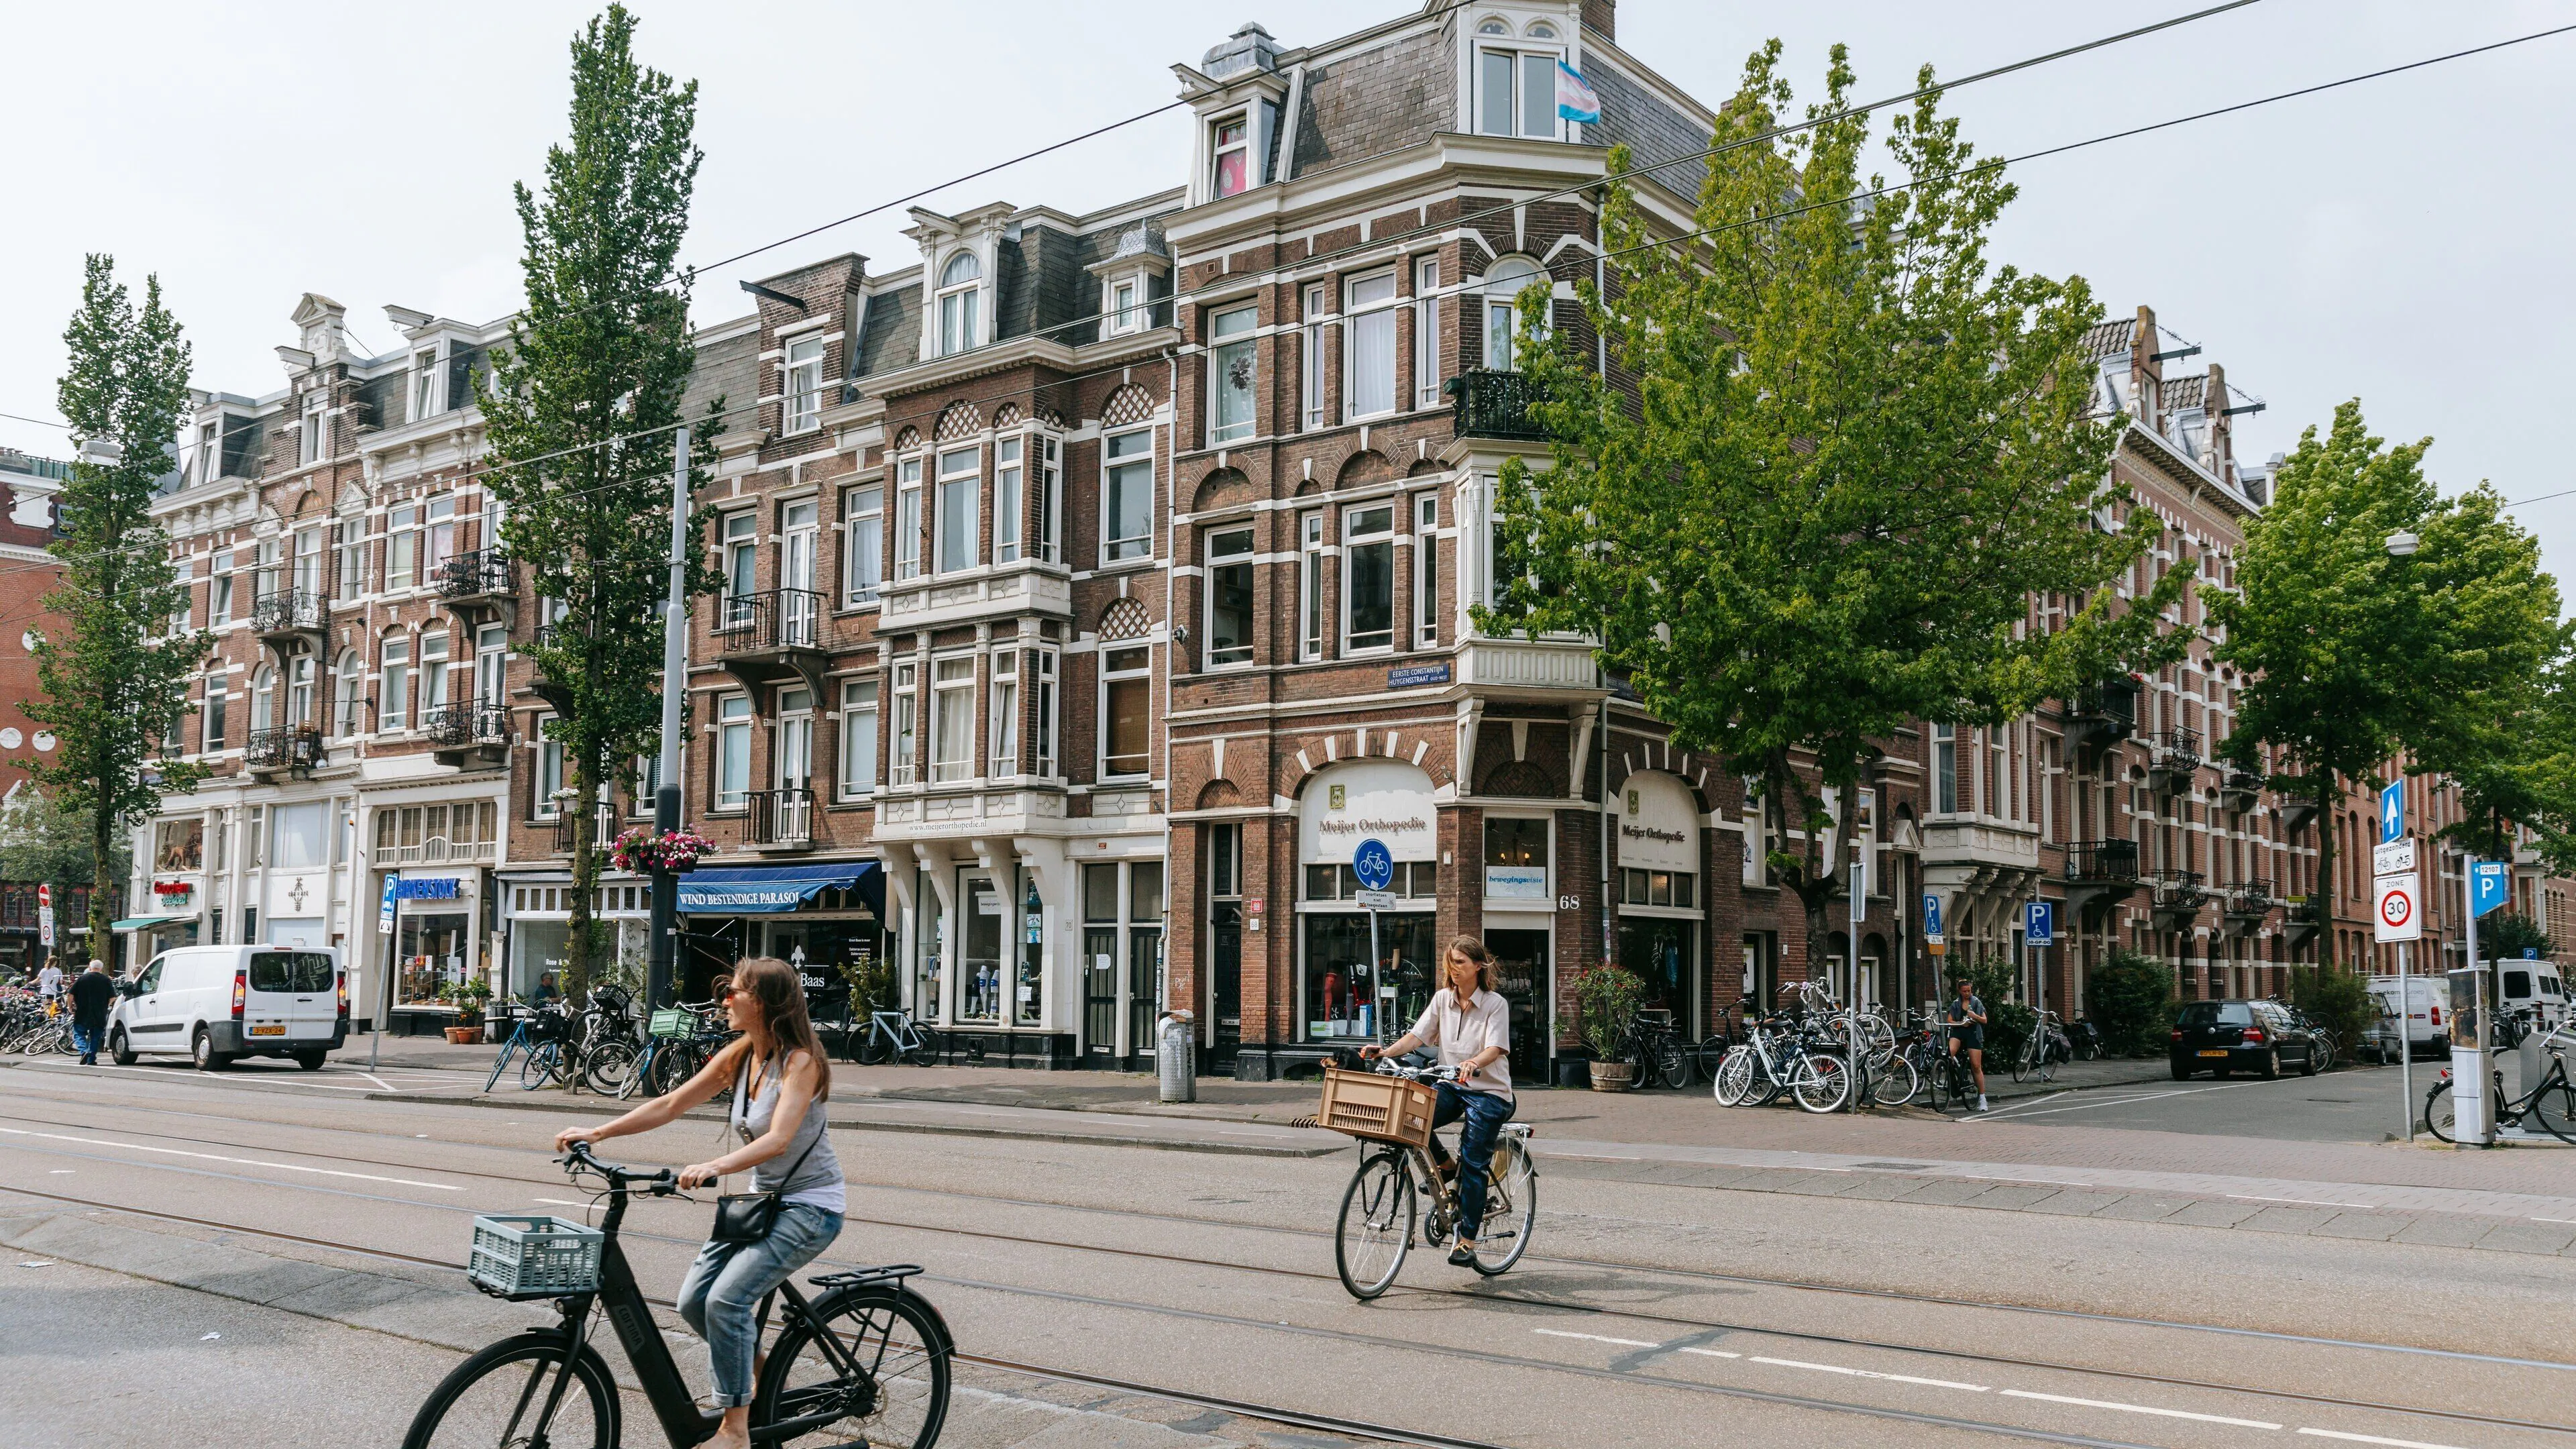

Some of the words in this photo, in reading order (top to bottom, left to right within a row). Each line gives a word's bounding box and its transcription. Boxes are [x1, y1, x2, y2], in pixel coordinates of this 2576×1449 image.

[1393, 669, 1409, 678] EERSTE
[1411, 665, 1444, 676] CONSTANTIJN
[1389, 675, 1429, 686] HUYGENSSTRAAT
[909, 820, 987, 831] www.meijerorthopedie.nl
[1319, 820, 1356, 835] Meijer
[1358, 816, 1426, 834] Orthopedie
[1622, 824, 1646, 840] Meijer
[1647, 827, 1686, 844] Orthopedie
[2375, 841, 2411, 854] uitgezonderd
[1489, 875, 1543, 884] bewegingsvisie
[2386, 879, 2405, 888] ZONE
[386, 878, 394, 897] P
[396, 878, 458, 900] BIRKENSTOCK
[2482, 877, 2494, 898] P
[680, 894, 706, 904] WIND
[708, 893, 759, 905] BESTENDIGE
[1560, 895, 1580, 910] 68
[1927, 898, 1937, 918] P
[2031, 906, 2045, 924] P
[2387, 901, 2406, 915] 30
[2526, 949, 2534, 959] P
[800, 973, 825, 987] Baas
